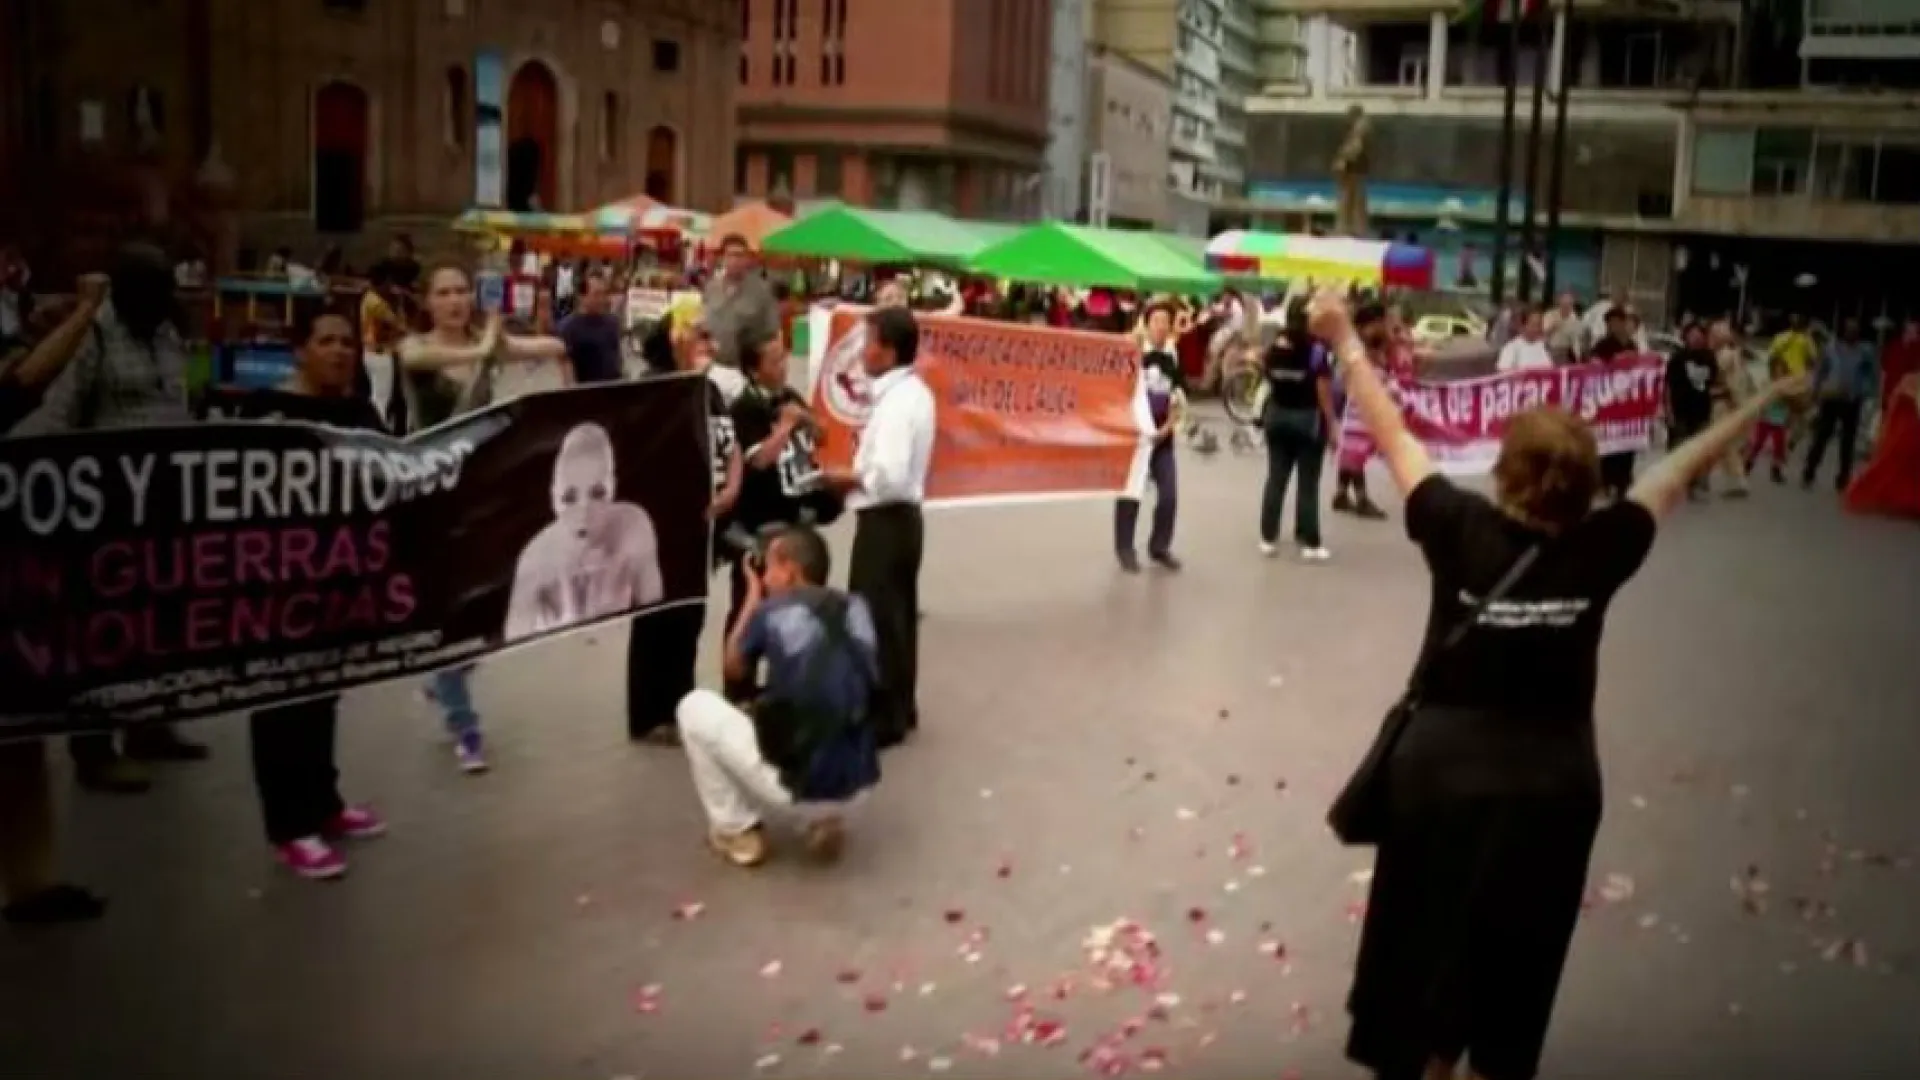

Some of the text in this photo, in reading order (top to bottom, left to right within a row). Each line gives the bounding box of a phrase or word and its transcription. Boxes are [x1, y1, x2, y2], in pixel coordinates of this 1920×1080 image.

[1480, 378, 1554, 435] parar
[1581, 368, 1661, 420] guerr
[117, 452, 157, 527] Y
[90, 519, 392, 598] GUERRAS
[15, 574, 417, 677] VIOLENCIAS
